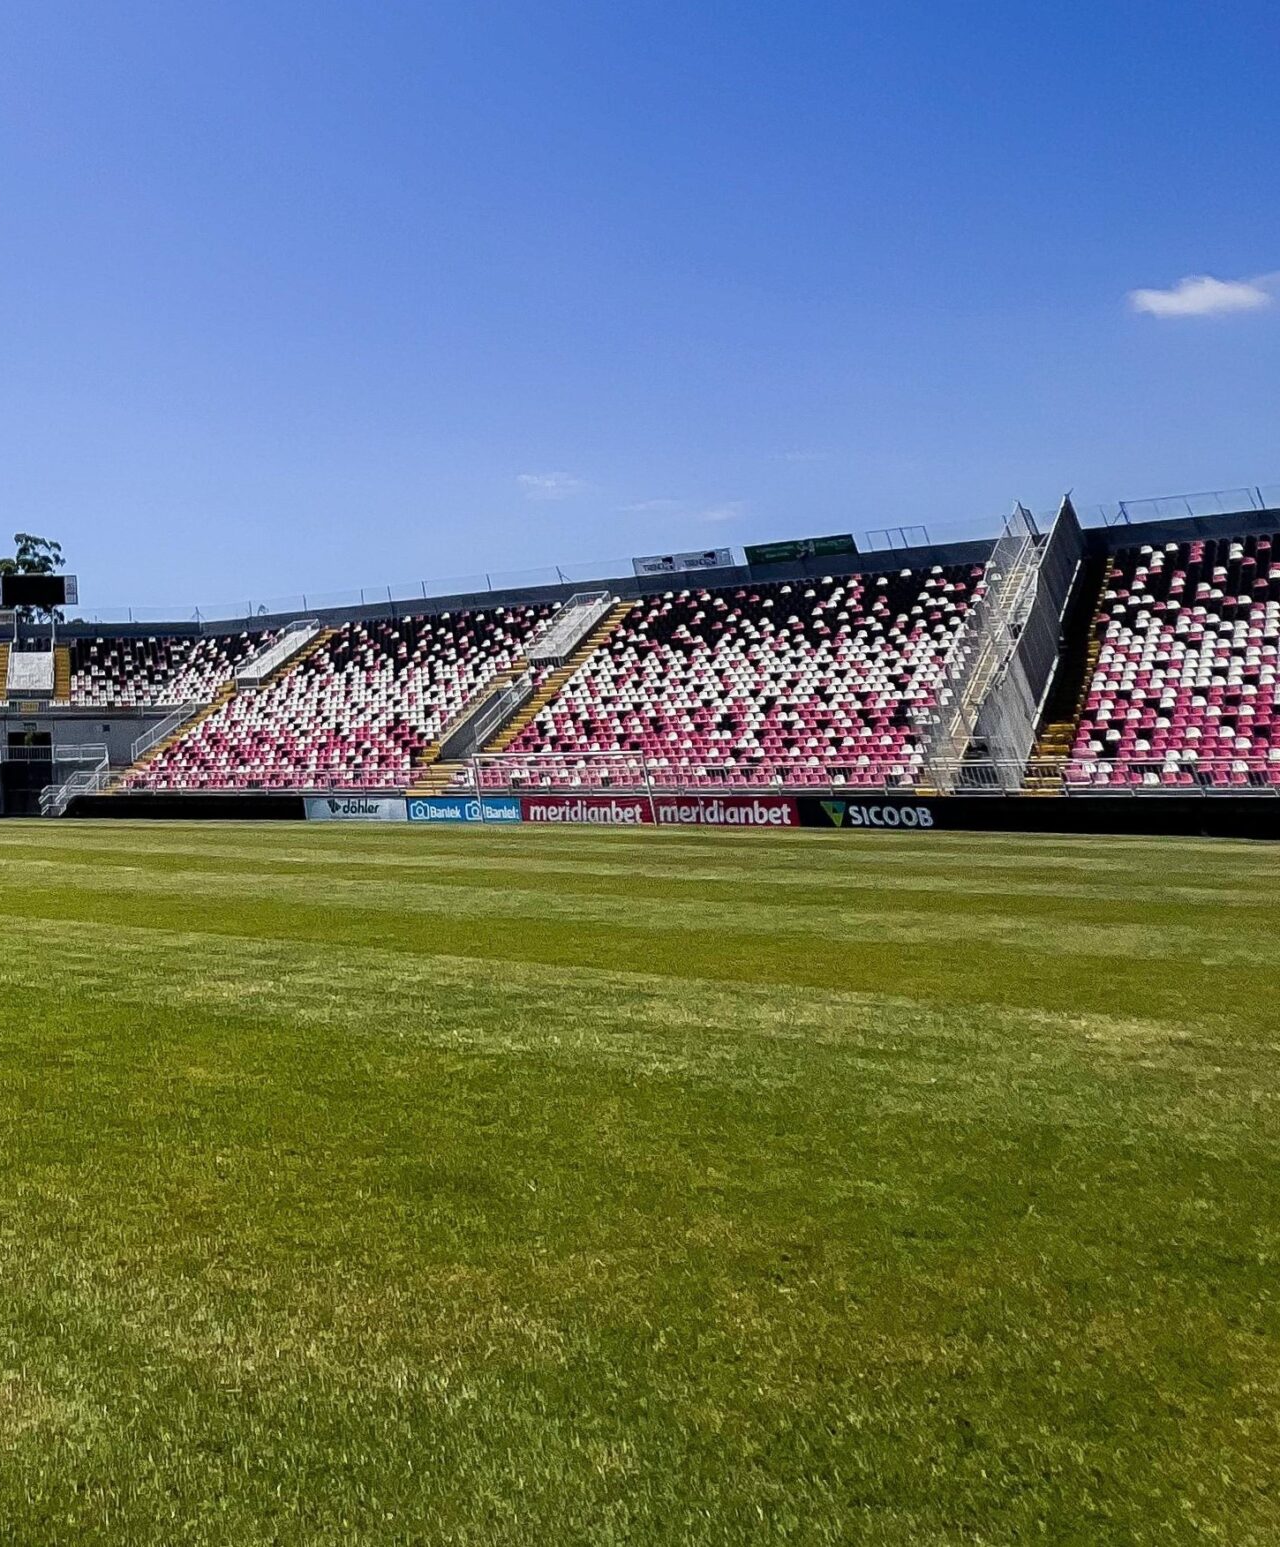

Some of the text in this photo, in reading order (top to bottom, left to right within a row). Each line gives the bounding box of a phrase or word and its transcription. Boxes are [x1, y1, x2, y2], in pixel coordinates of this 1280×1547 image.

[342, 800, 379, 814] döhler
[529, 800, 643, 823] meridianbet
[658, 800, 790, 824] meridianbet
[848, 806, 933, 826] SICOOB
